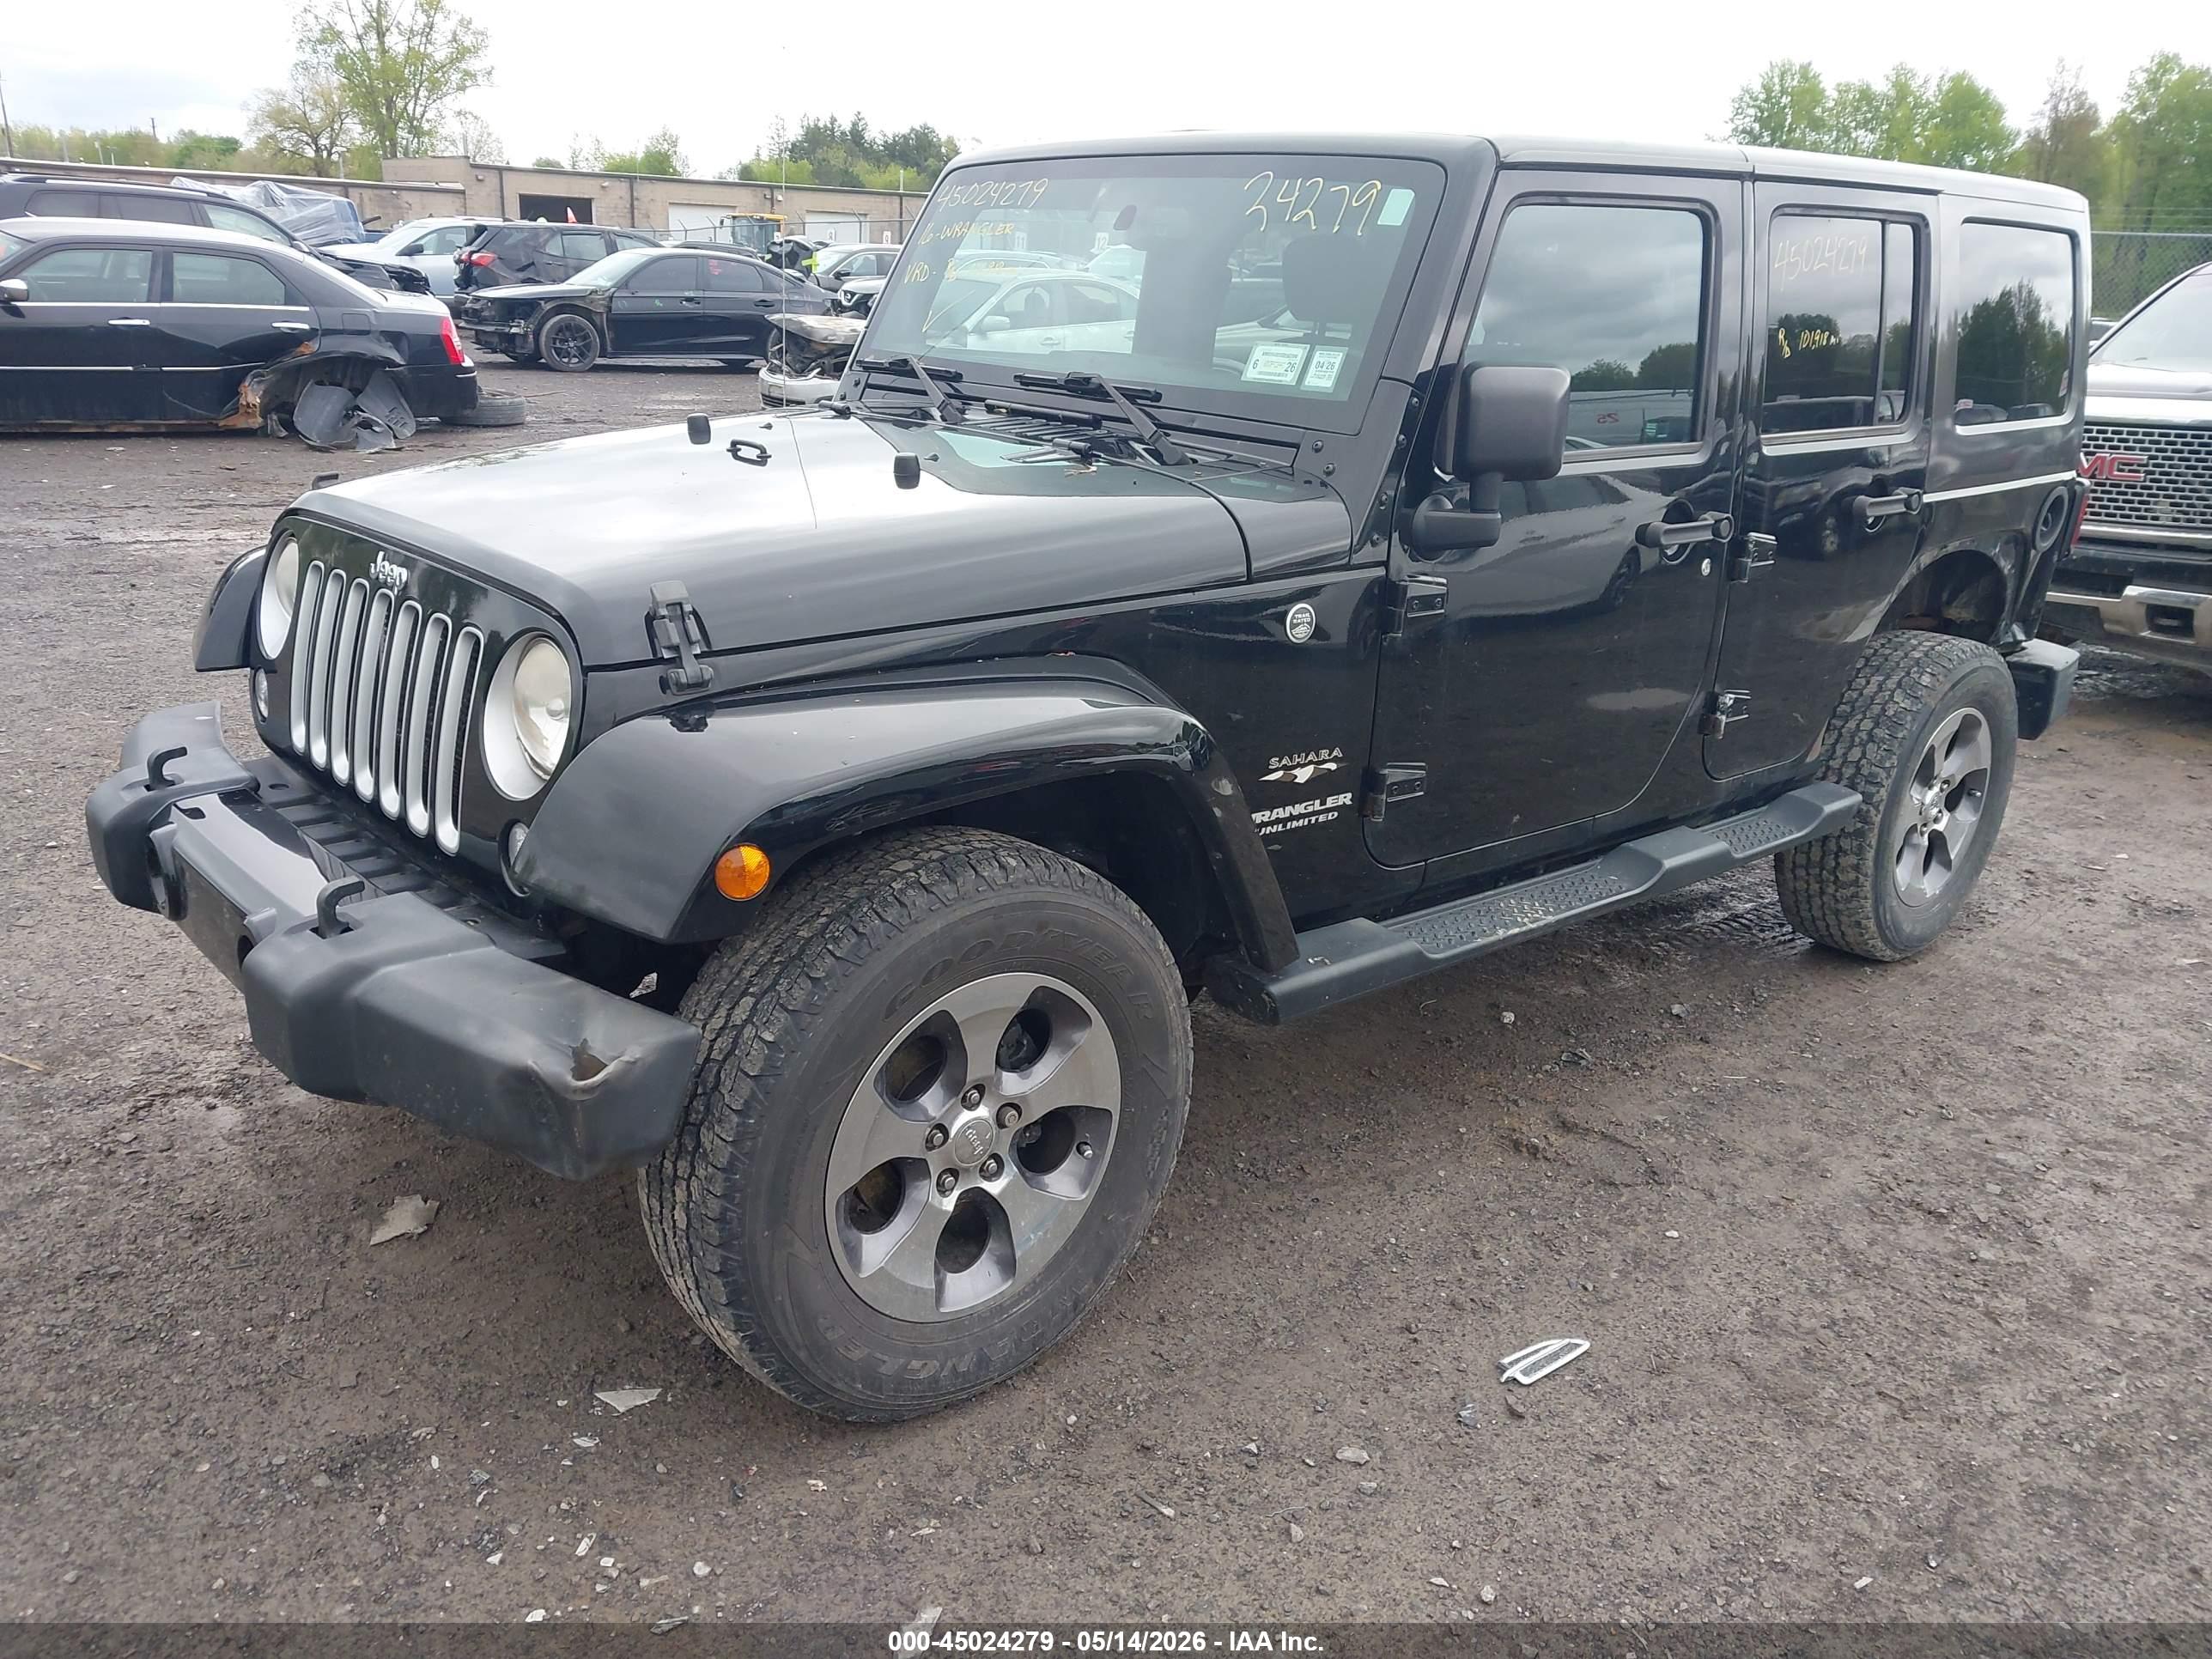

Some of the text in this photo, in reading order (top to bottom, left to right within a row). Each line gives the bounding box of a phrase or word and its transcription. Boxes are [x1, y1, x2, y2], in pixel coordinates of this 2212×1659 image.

[937, 178, 1049, 212] 45024279
[1243, 170, 1382, 236] 24279
[1774, 237, 1869, 292] 45024279
[1252, 359, 1260, 369] 6
[1284, 362, 1297, 373] 26
[2076, 451, 2148, 482] MC
[369, 550, 408, 596] Jeep
[1268, 747, 1343, 769] SAHARA
